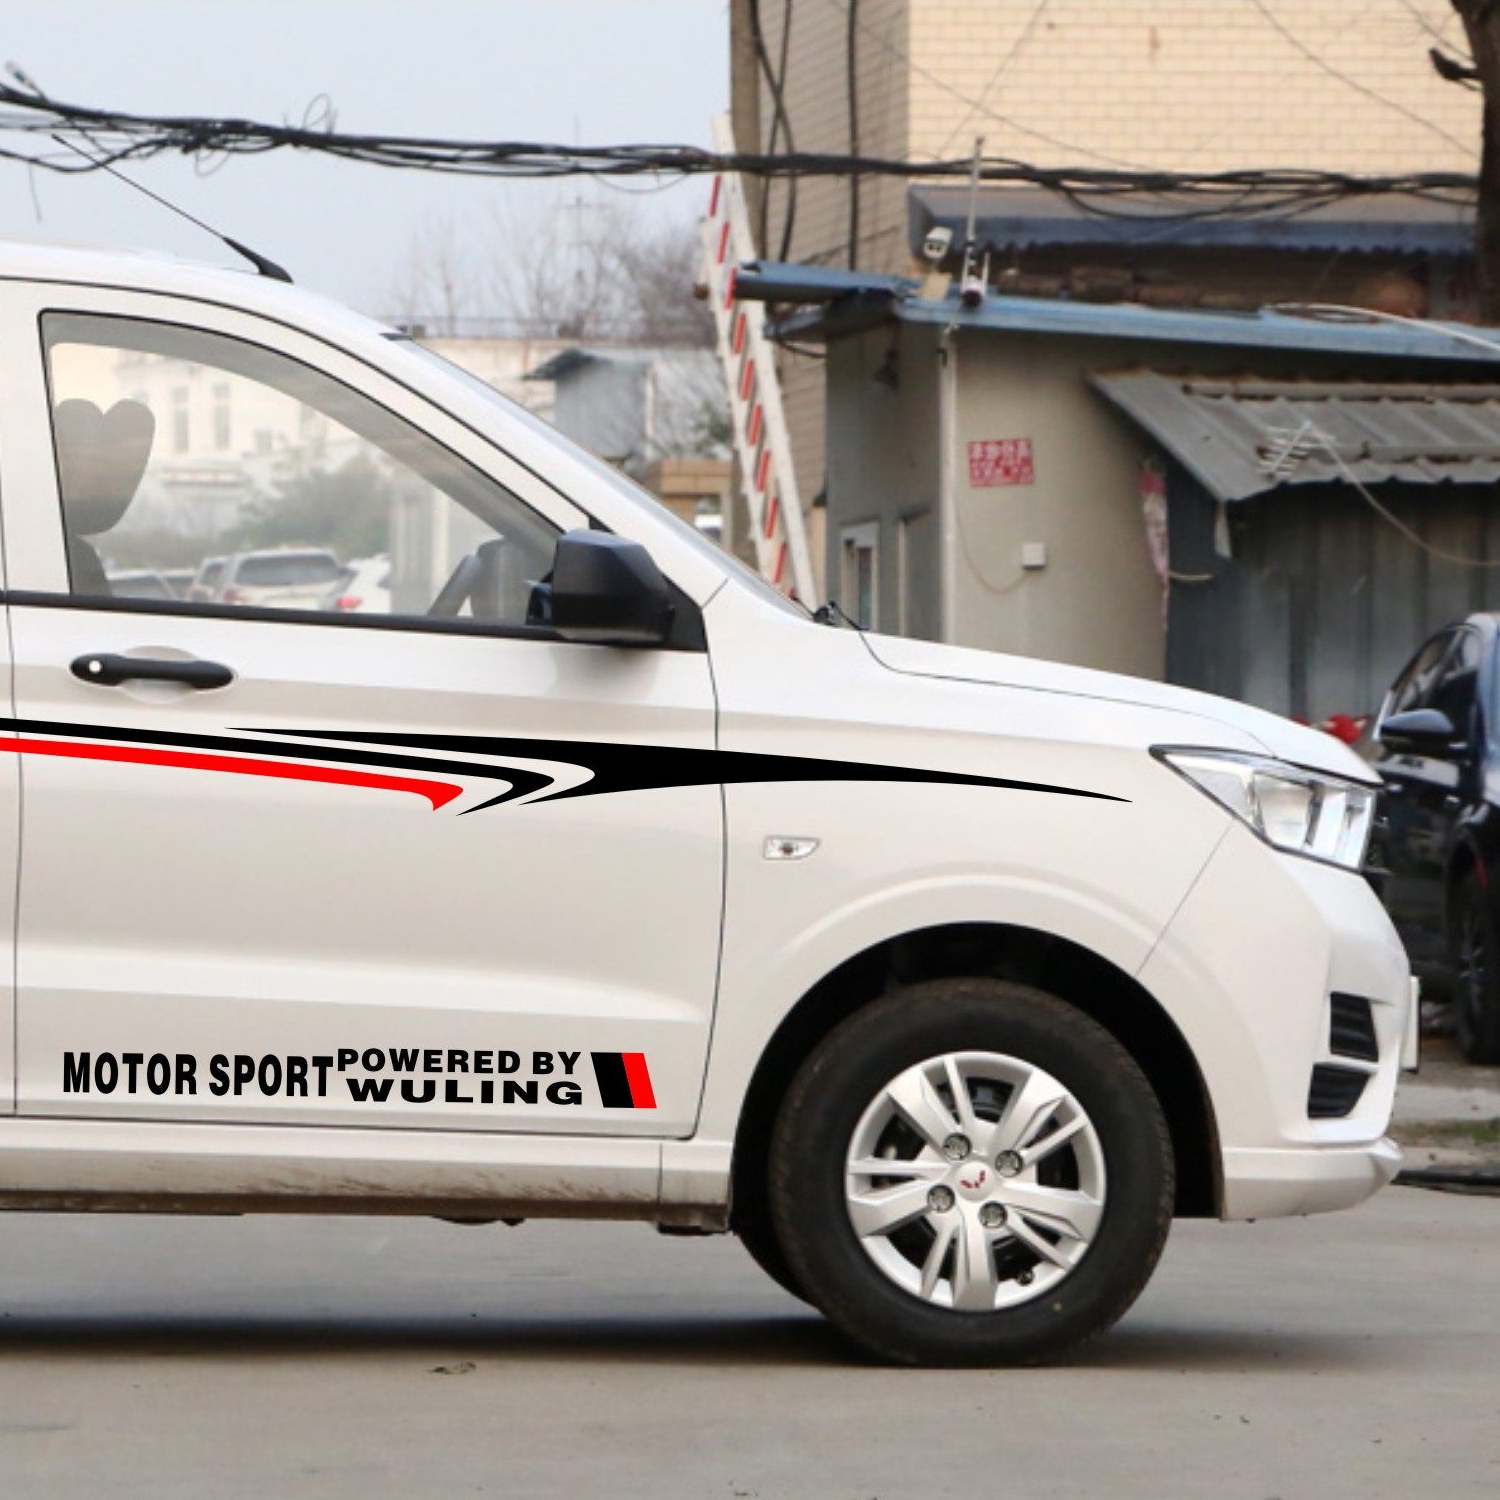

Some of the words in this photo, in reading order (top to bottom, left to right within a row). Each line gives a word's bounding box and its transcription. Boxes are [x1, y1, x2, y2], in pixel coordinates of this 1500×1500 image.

[62, 1050, 199, 1096] MOTOR
[208, 1053, 335, 1098] SPORT
[336, 1047, 522, 1075] POWERED
[531, 1050, 583, 1076] BY
[344, 1077, 584, 1107] WULING
